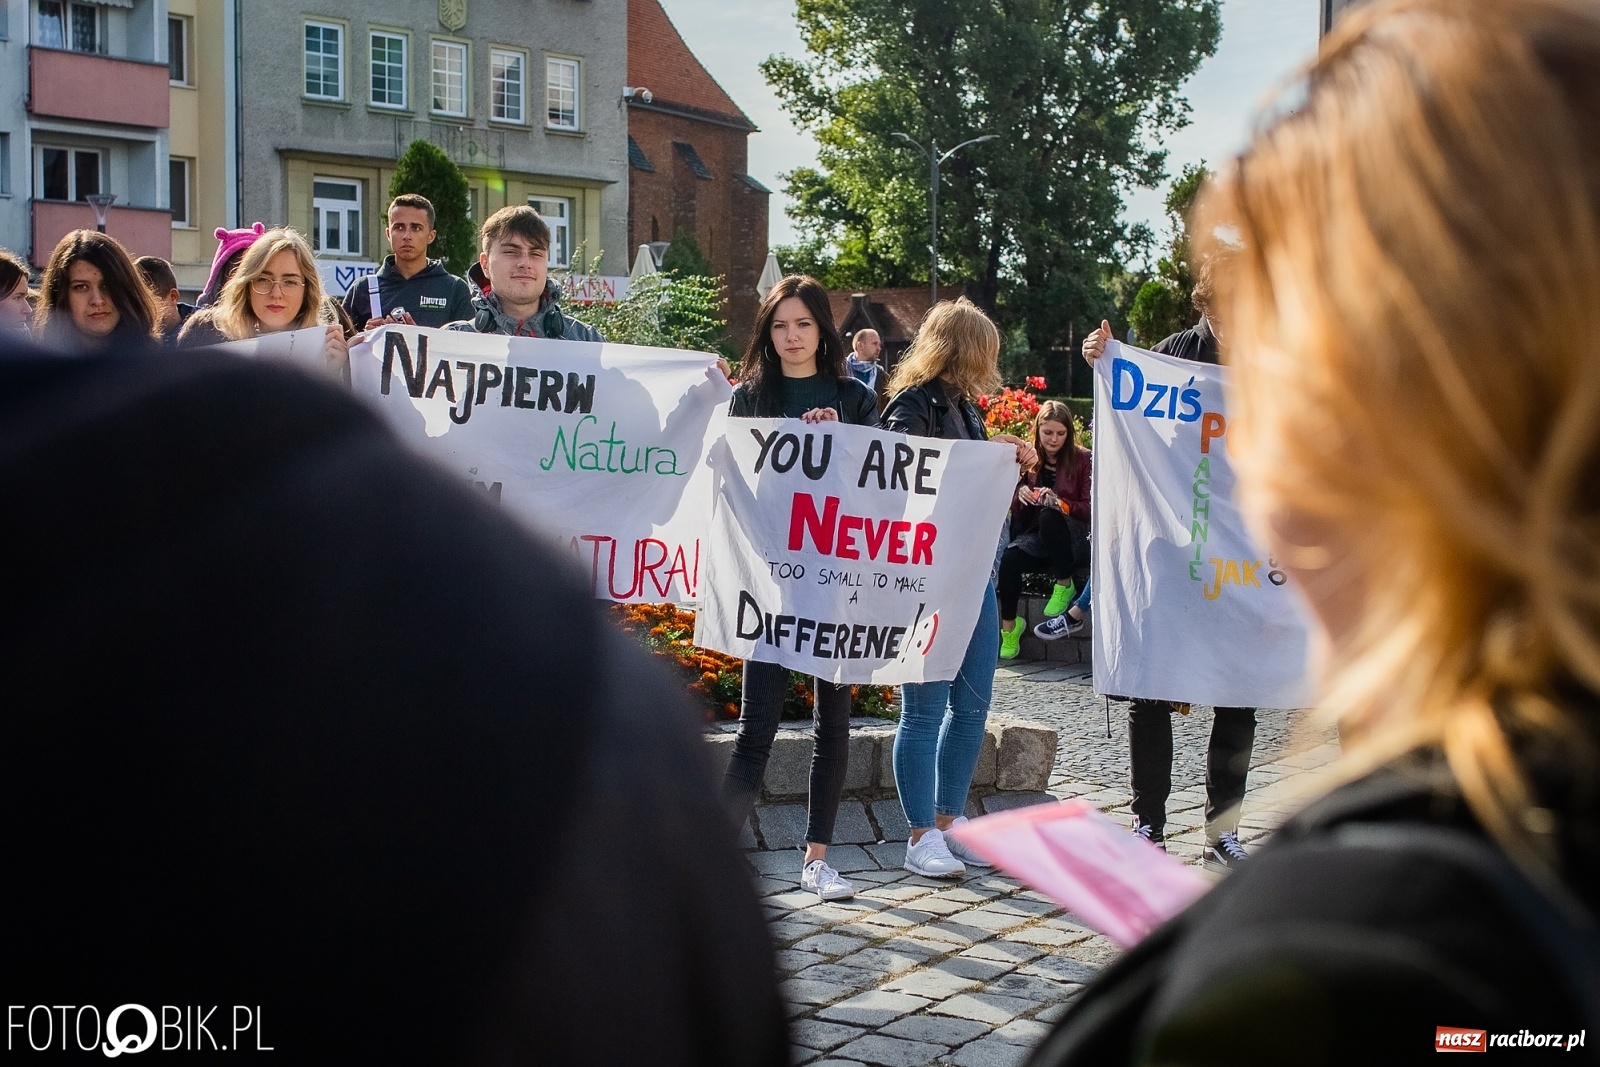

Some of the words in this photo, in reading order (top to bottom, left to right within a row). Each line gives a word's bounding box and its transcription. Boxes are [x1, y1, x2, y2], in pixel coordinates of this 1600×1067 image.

[380, 331, 596, 425] NAJPIERW
[1111, 357, 1202, 423] DZIŚ
[540, 415, 688, 476] Natura
[750, 428, 833, 480] YOU
[857, 439, 941, 495] ARE
[787, 491, 938, 566] NEVER
[768, 561, 806, 579] TOO
[817, 568, 863, 588] SMALL
[873, 572, 888, 589] TO
[894, 576, 927, 593] MAKE
[848, 589, 859, 605] A
[1203, 557, 1263, 601] JAK
